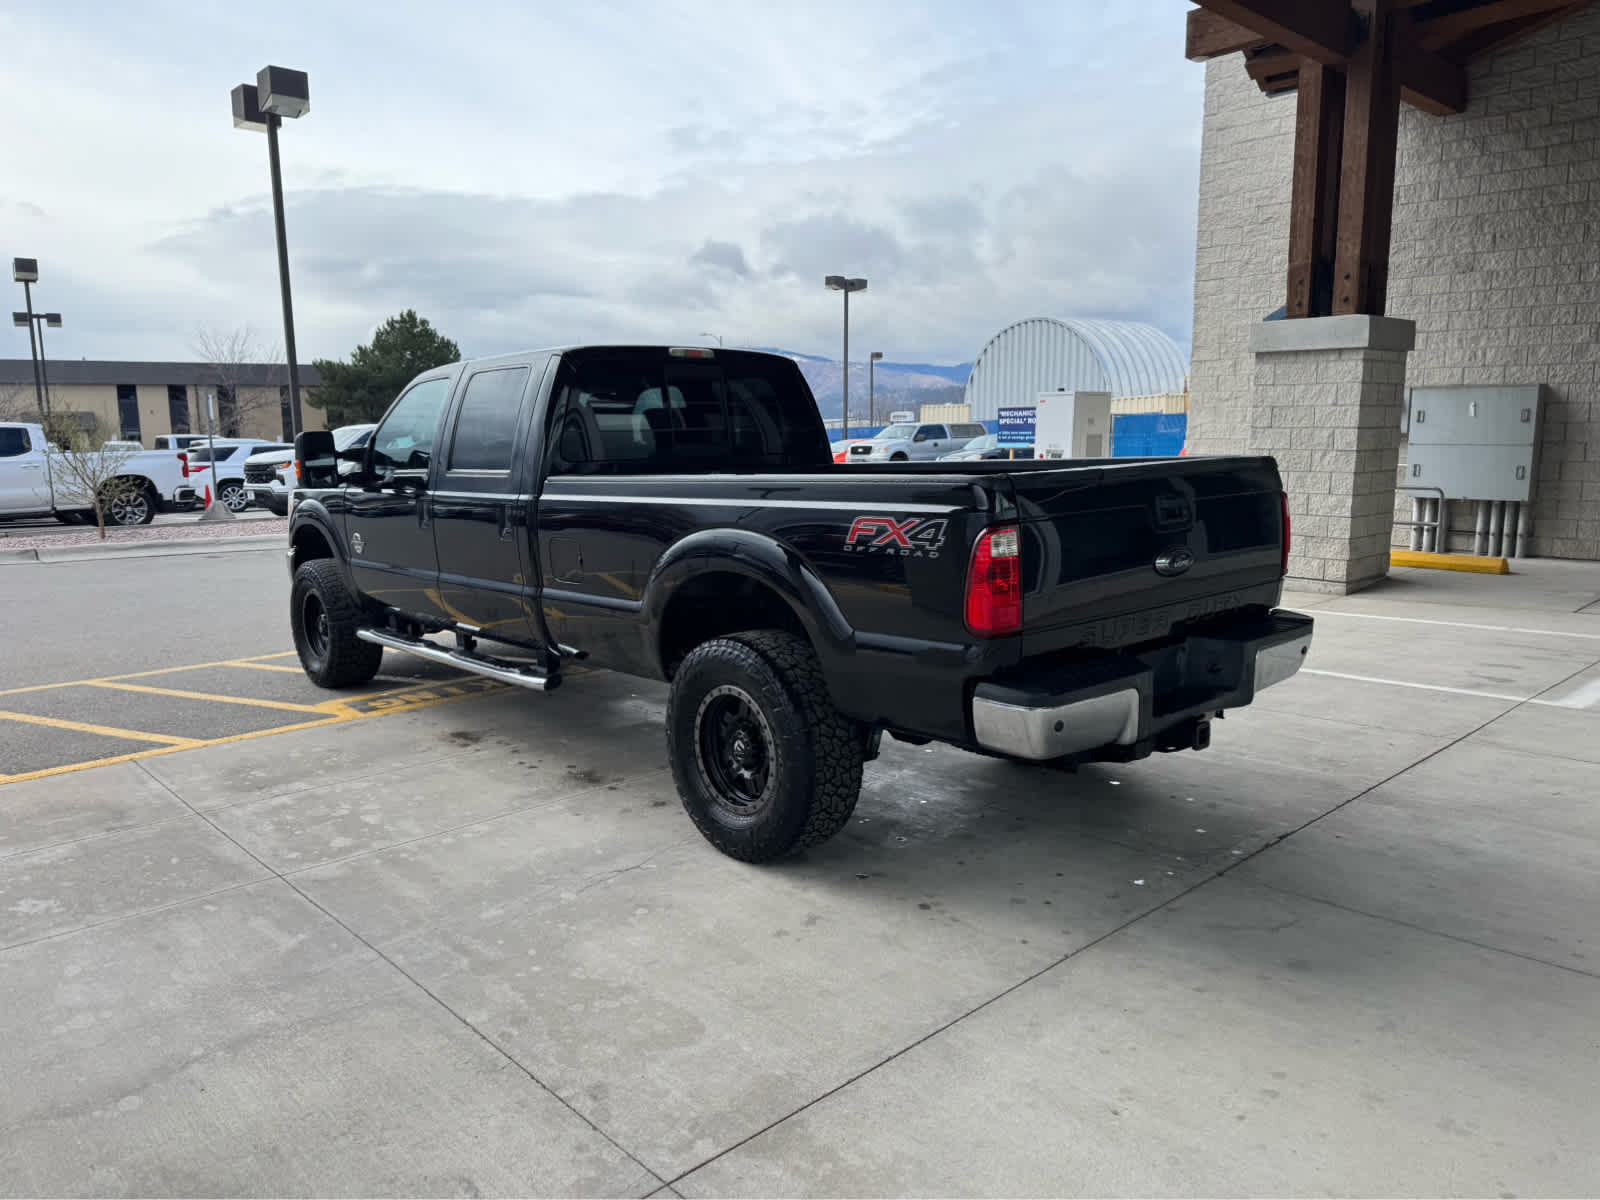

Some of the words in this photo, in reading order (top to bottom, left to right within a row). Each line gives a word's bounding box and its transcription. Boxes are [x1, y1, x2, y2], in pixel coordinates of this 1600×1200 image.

[846, 516, 949, 550] FX4
[843, 543, 879, 553] OFF
[884, 547, 940, 559] ROAD
